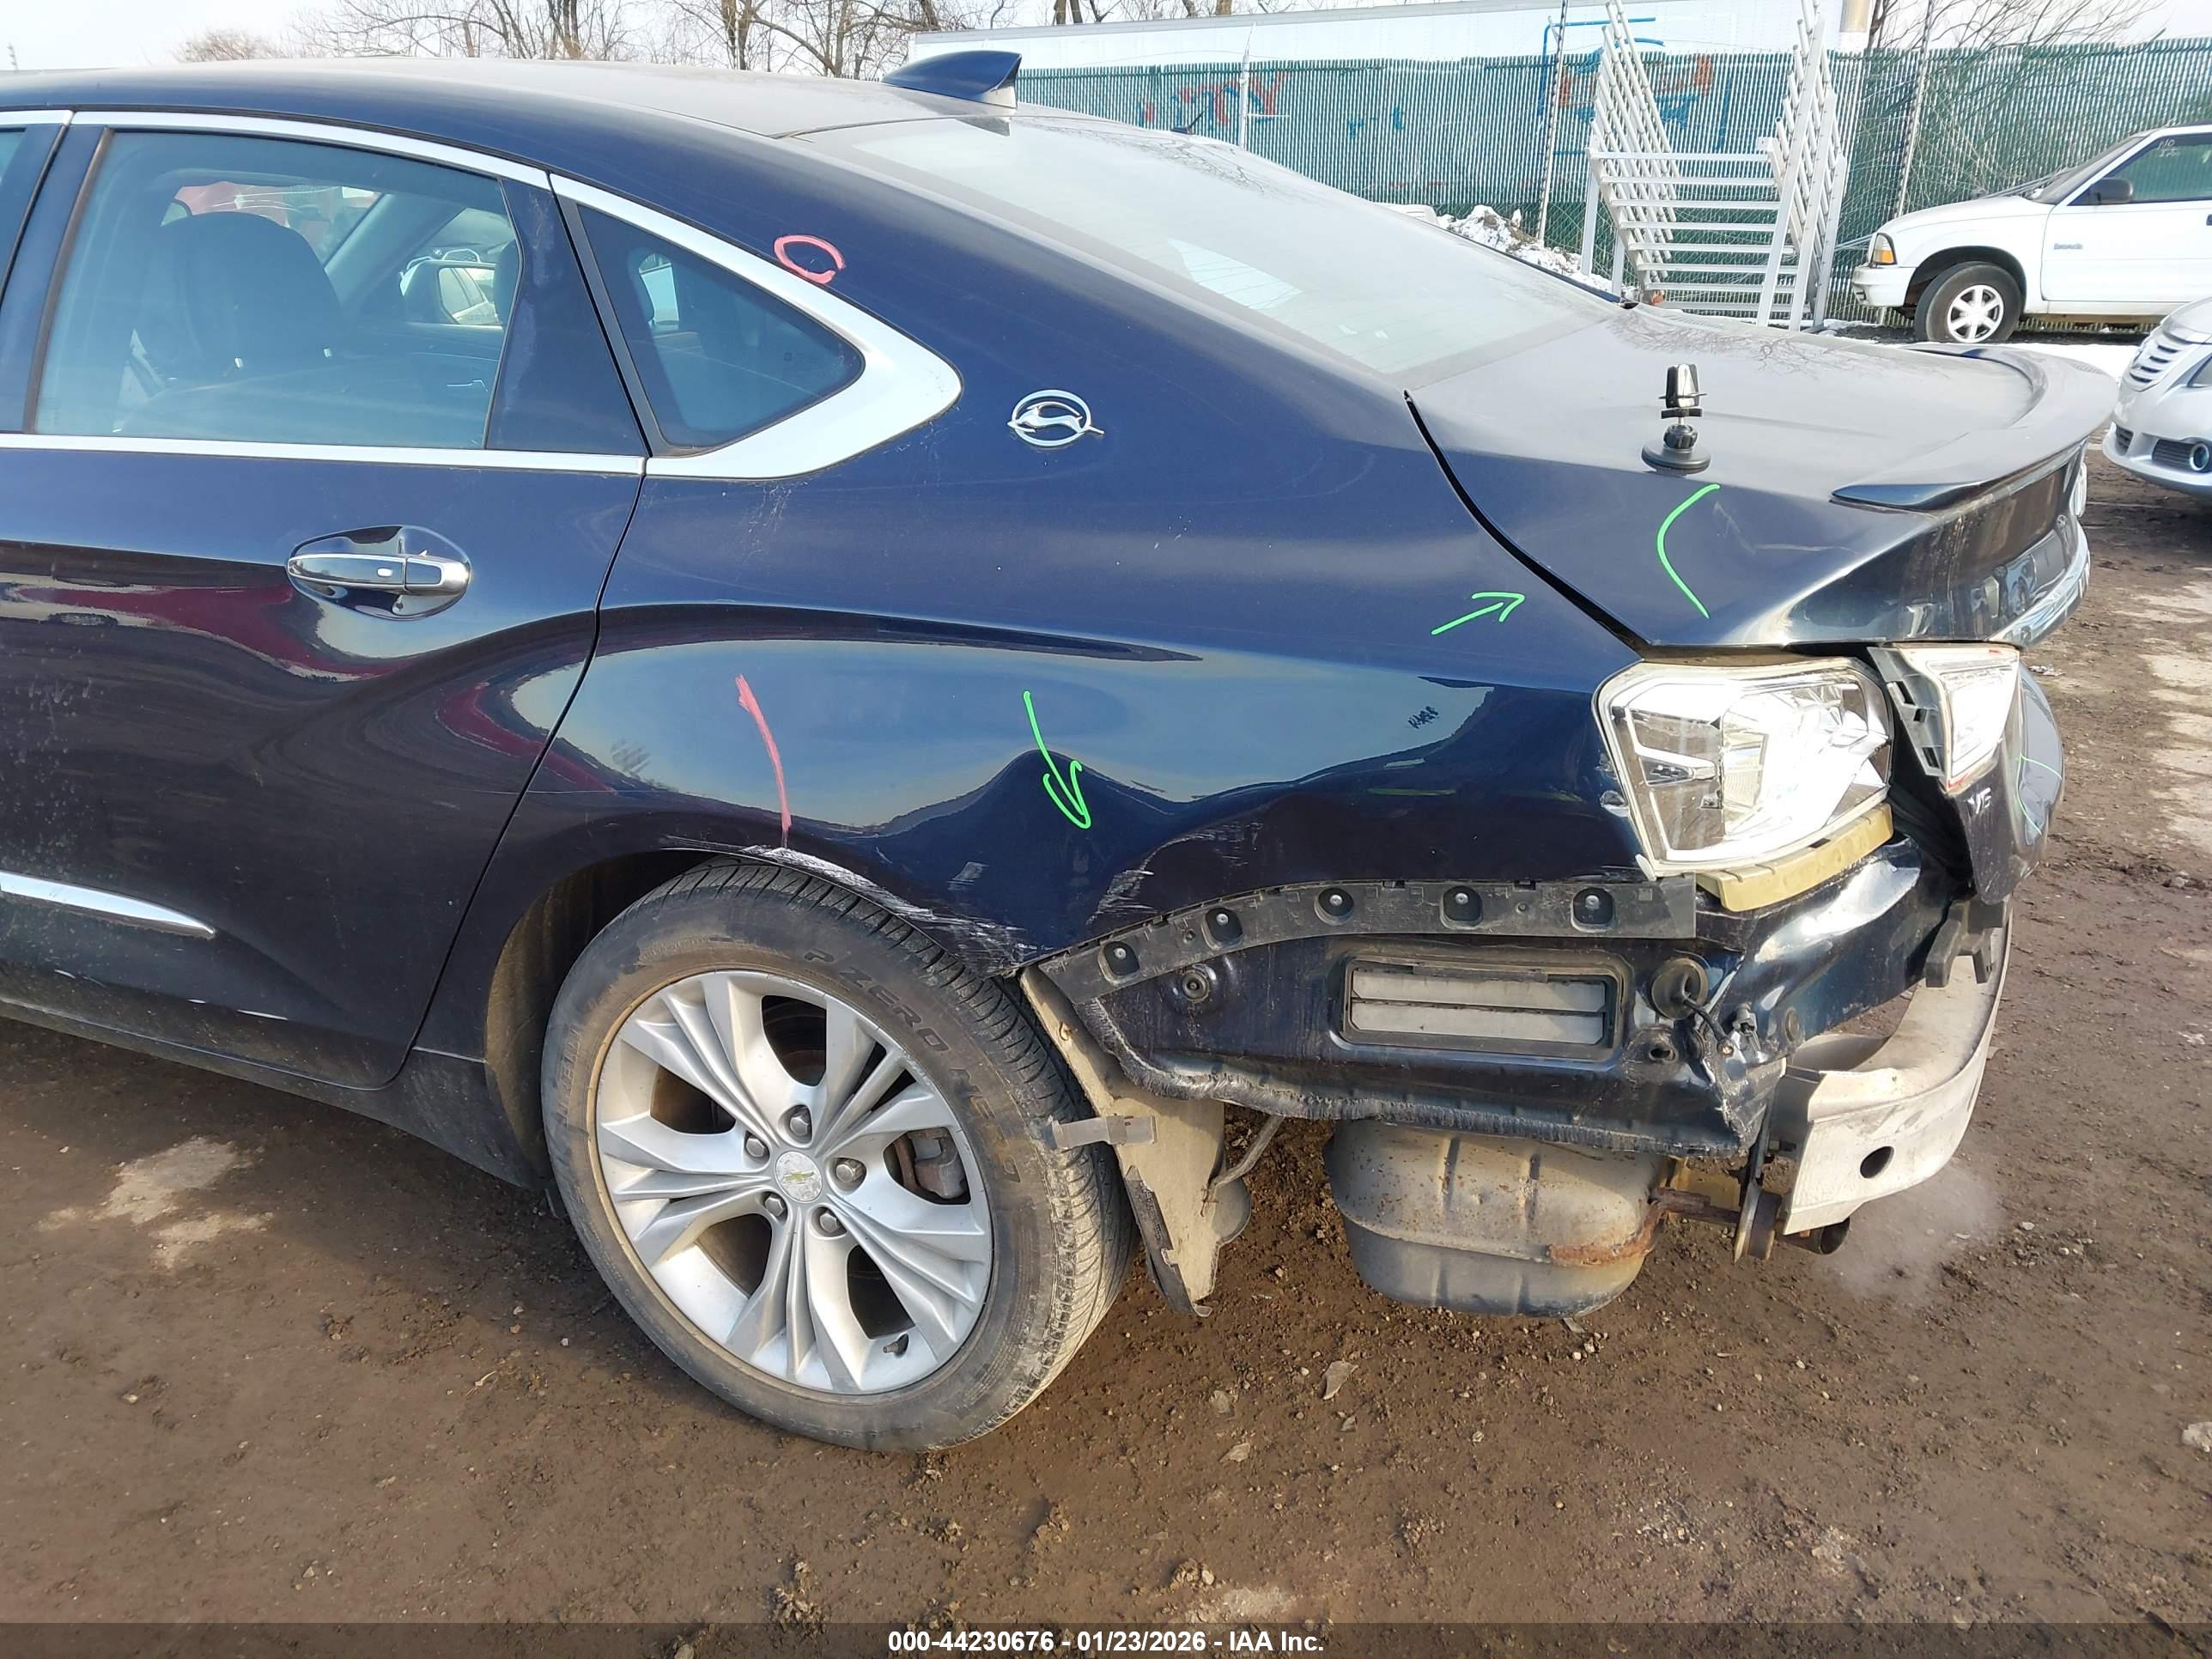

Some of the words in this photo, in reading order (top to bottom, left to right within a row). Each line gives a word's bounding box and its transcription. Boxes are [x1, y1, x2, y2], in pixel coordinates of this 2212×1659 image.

[1966, 787, 1992, 814] V6
[805, 948, 835, 963] P
[838, 966, 951, 1052] ZERO
